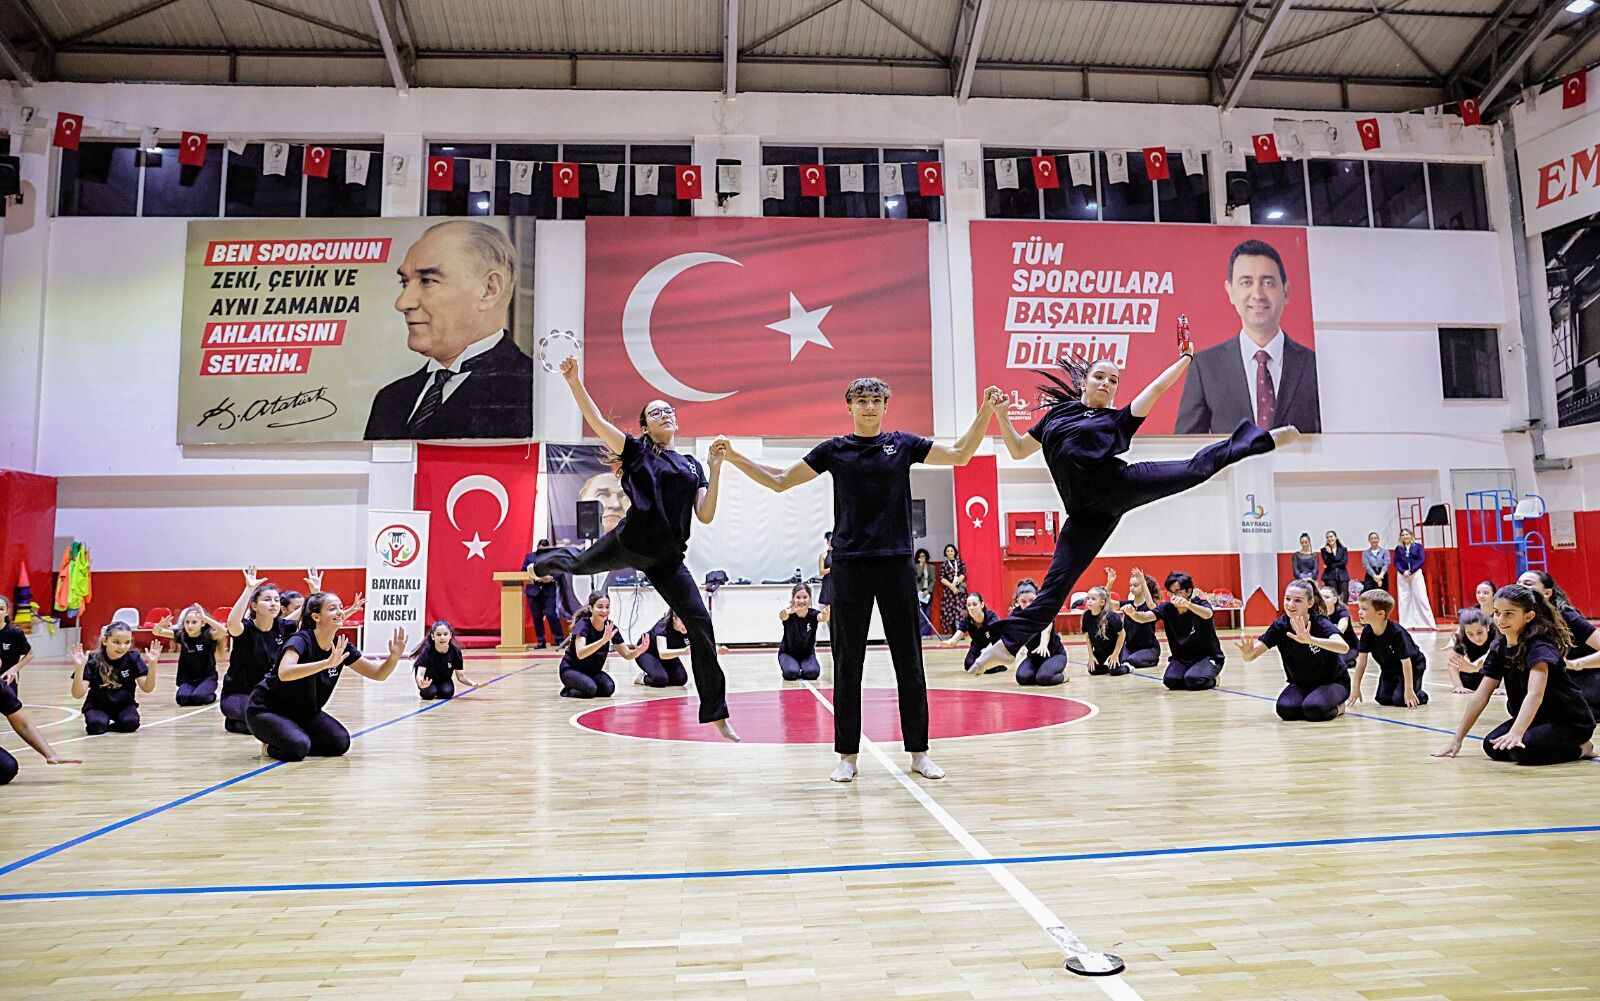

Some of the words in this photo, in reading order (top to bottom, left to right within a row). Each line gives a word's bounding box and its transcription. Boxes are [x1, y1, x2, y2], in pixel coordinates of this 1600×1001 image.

[212, 244, 254, 262] BEN
[257, 242, 382, 262] SPORCUNUN
[1011, 236, 1064, 265] TÜM
[211, 266, 261, 291] ZEKİ,
[268, 265, 329, 291] ÇEVİK
[334, 269, 358, 286] VE
[1011, 269, 1175, 294] SPORCULARA
[209, 298, 259, 316] AYNI
[262, 296, 360, 315] ZAMANDA
[1014, 302, 1153, 328] BAŞARILAR
[207, 323, 338, 344] AHLAKLISINI
[207, 348, 303, 373] SEVERİM.
[1014, 336, 1124, 366] DİLERİM.
[372, 578, 421, 590] BAYRAKLI
[383, 594, 409, 606] KENT
[373, 608, 417, 621] KONSEYİ
